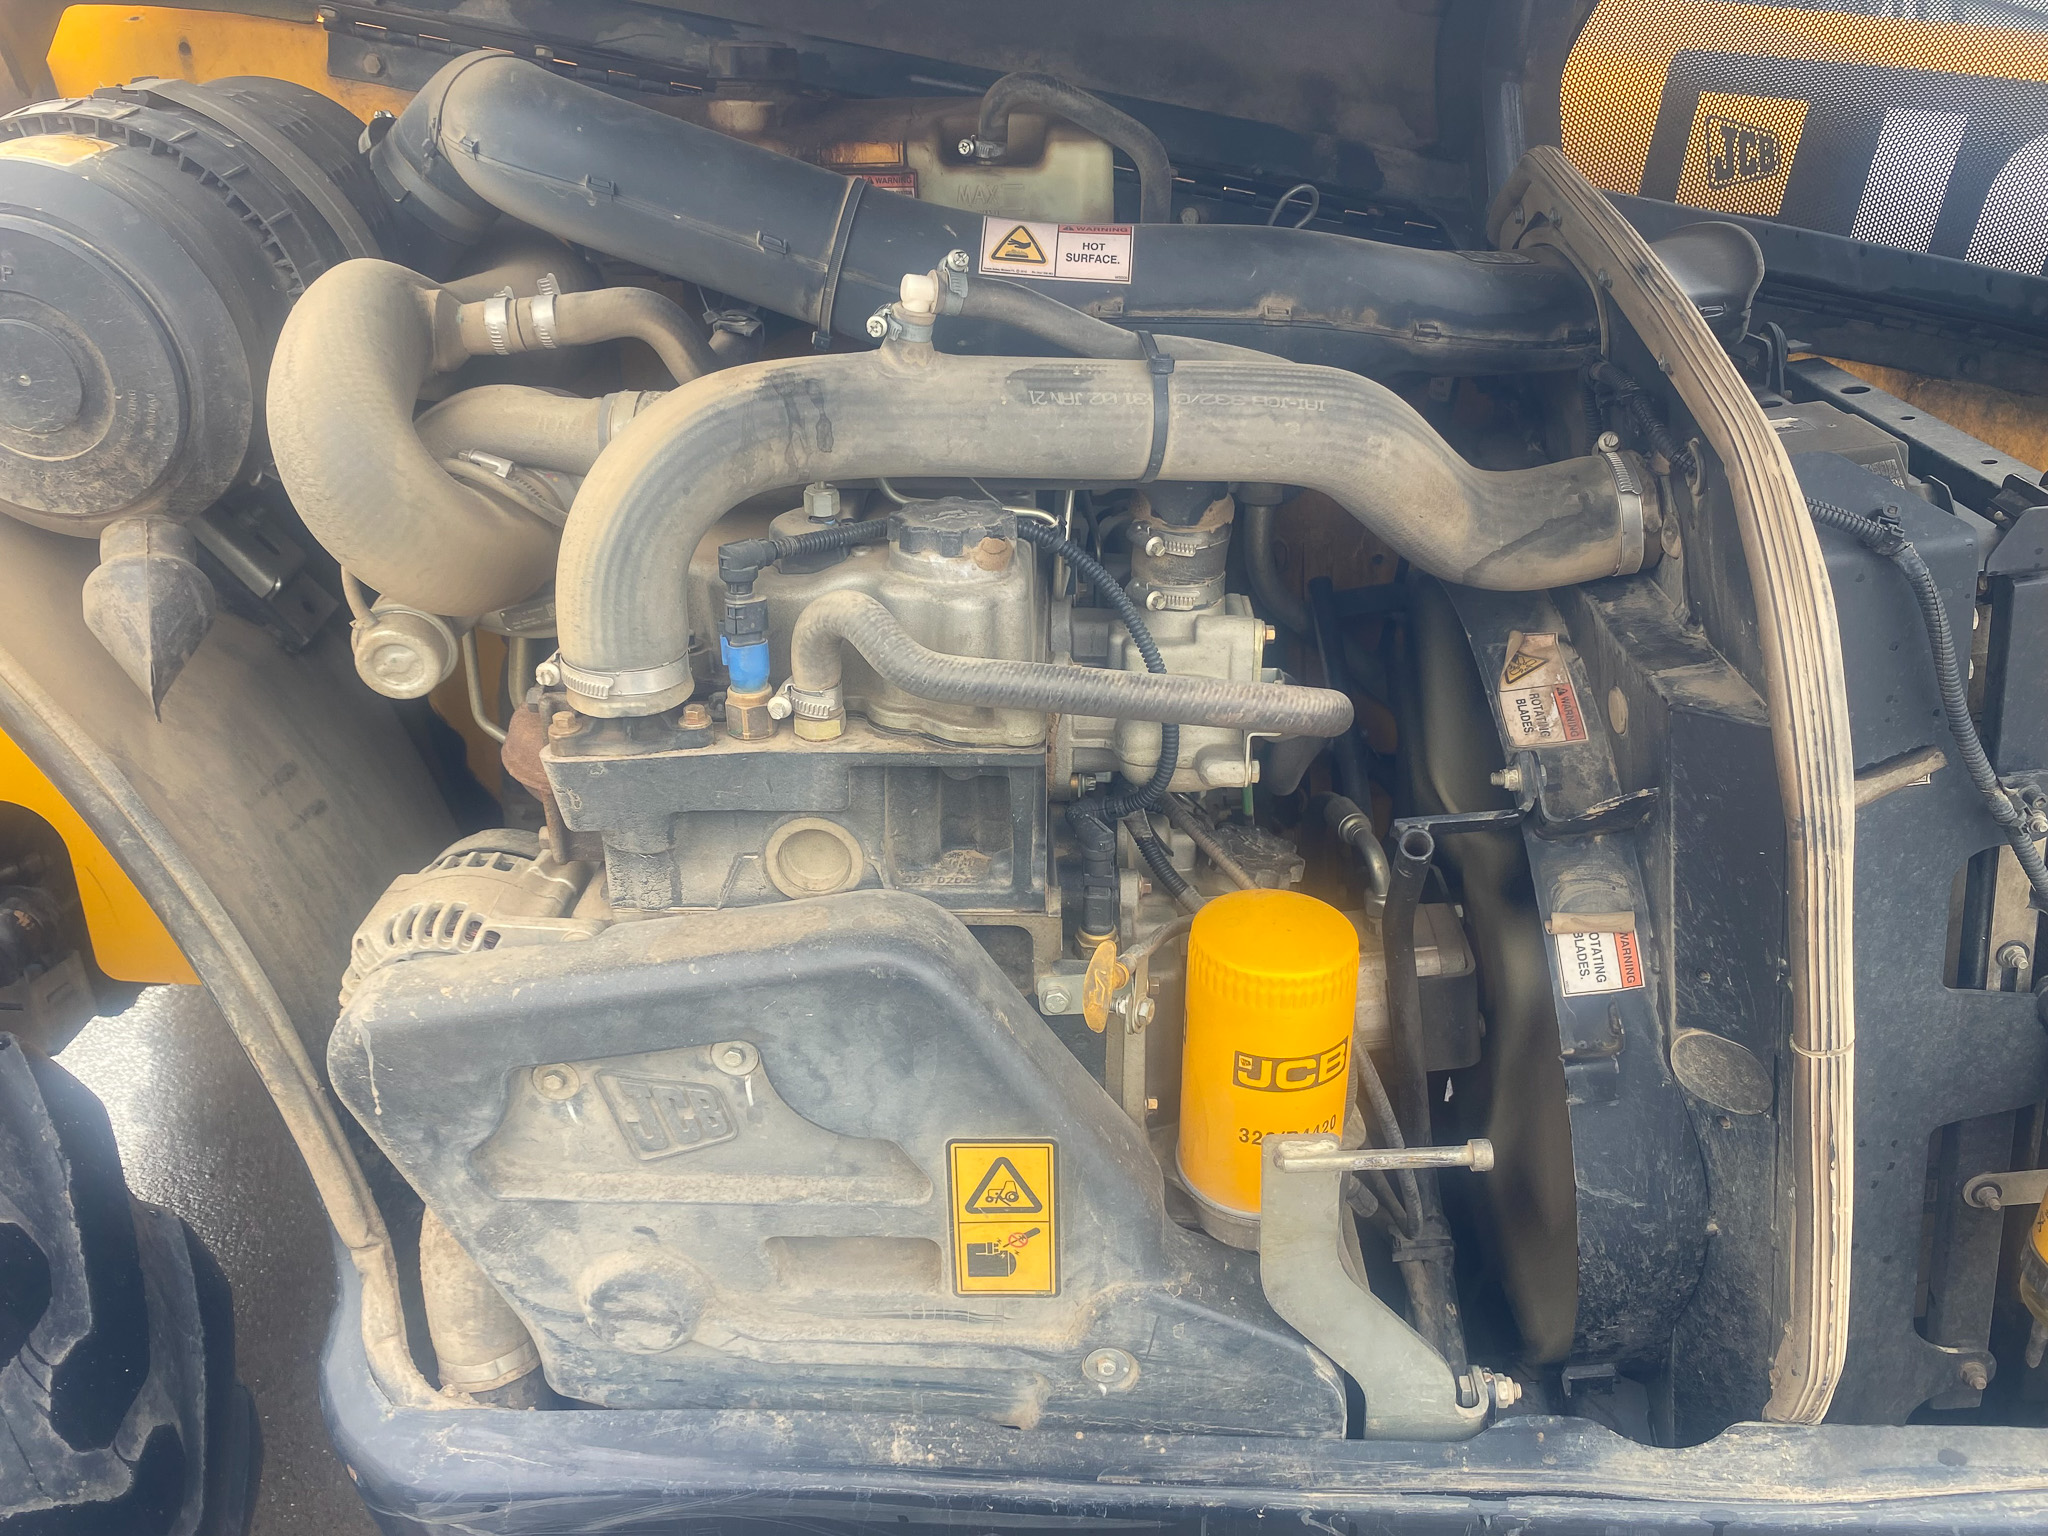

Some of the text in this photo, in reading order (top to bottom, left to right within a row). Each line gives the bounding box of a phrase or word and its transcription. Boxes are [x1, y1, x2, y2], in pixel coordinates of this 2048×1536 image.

[1715, 126, 1775, 179] JCB
[875, 176, 912, 185] WARNING
[957, 184, 999, 204] MAX
[1076, 225, 1128, 233] WARNING
[1082, 242, 1106, 251] HOT
[1065, 252, 1120, 265] SURFACE.
[1028, 390, 1048, 406] 21
[1515, 698, 1535, 736] BLADES.
[1529, 692, 1551, 737] ROTATING
[1561, 695, 1580, 738] WARNING
[1588, 932, 1607, 983] OTATING
[1237, 1042, 1347, 1090] JCB
[617, 1080, 729, 1152] JCB
